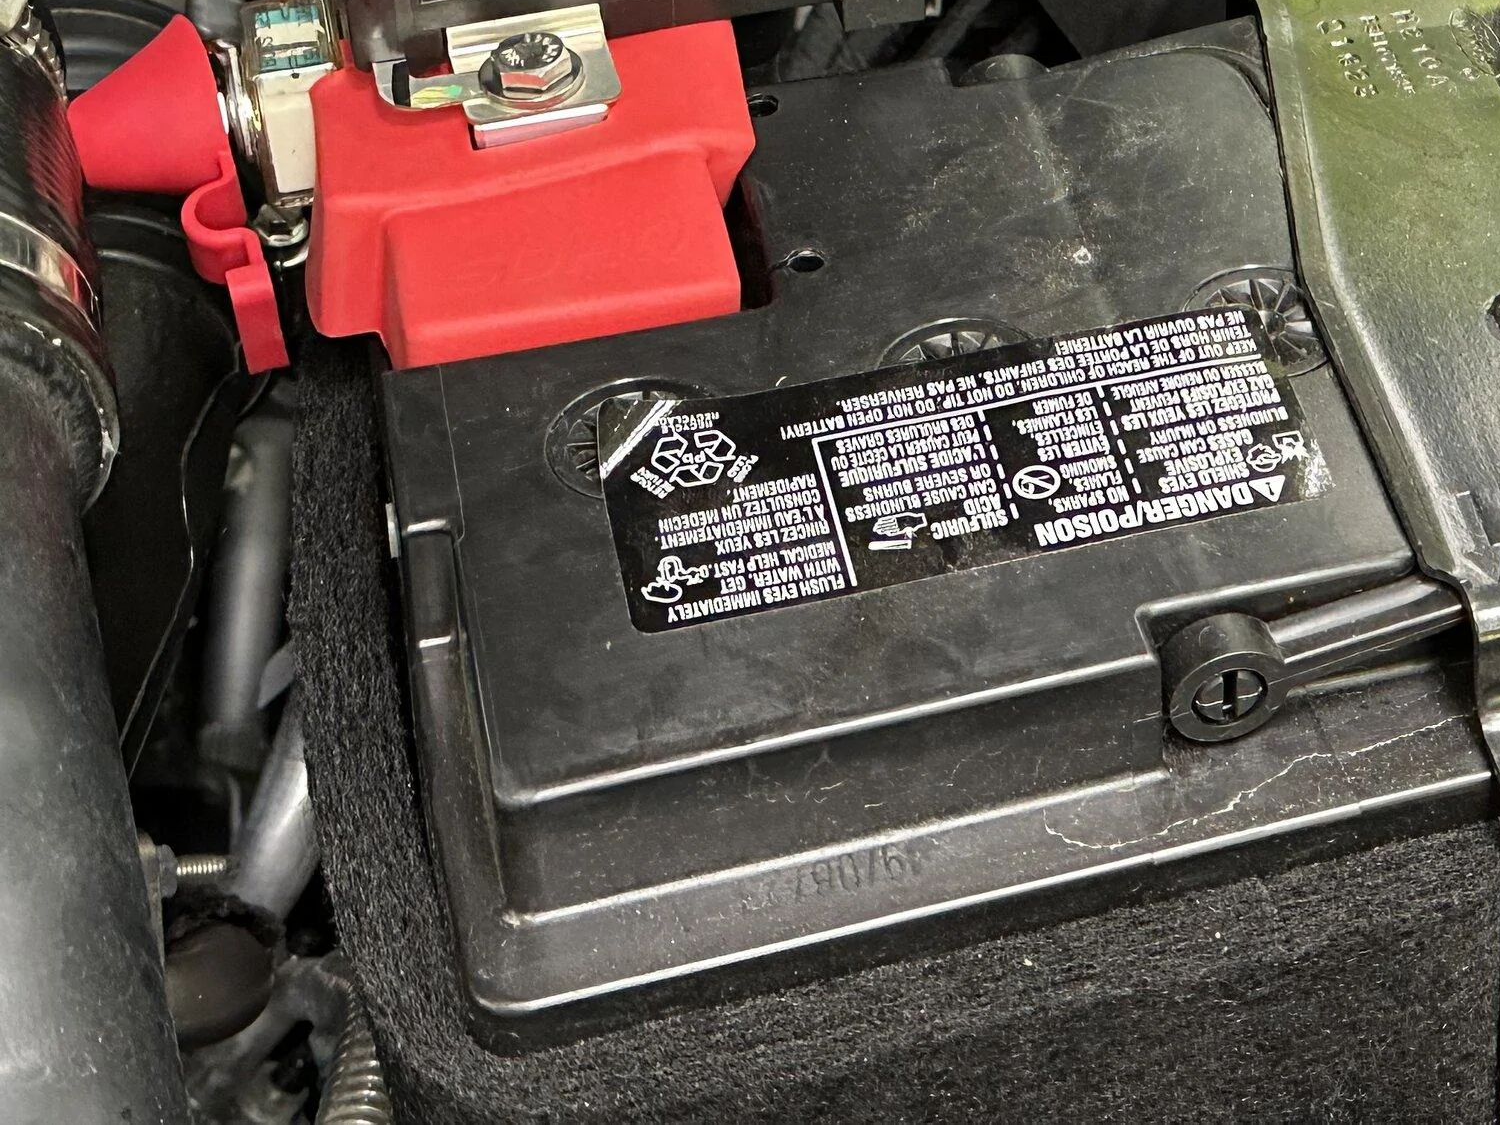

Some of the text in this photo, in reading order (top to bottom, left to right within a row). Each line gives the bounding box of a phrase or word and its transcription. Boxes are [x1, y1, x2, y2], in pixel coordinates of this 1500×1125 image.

[1196, 313, 1224, 329] PAS
[1224, 310, 1245, 325] NE
[1123, 327, 1143, 343] LA
[1144, 317, 1195, 339] OUVRIR
[1210, 324, 1251, 342] TENIR
[1149, 338, 1170, 353] DE
[1170, 330, 1209, 348] HORS
[1223, 338, 1256, 355] KEEP
[1129, 342, 1149, 357] LA
[1178, 347, 1195, 362] OF
[1197, 343, 1223, 359] OUT
[1046, 355, 1075, 371] DES
[1106, 357, 1150, 375] REACH
[1149, 351, 1177, 367] THE
[1087, 364, 1105, 379] OF
[1202, 367, 1220, 382] OU
[926, 379, 955, 396] PAS
[956, 375, 976, 390] NE
[994, 382, 1014, 398] DO
[966, 386, 993, 404] NOT
[1032, 391, 1092, 414] DE FUMER
[1130, 390, 1180, 412] PEUVENT
[886, 402, 913, 419] NOT
[914, 398, 935, 413] DO
[1074, 405, 1098, 422] LES
[1185, 400, 1212, 418] LES
[846, 408, 883, 426] OPEN
[949, 414, 974, 431] DES
[1120, 412, 1148, 430] LES
[1147, 405, 1185, 426] YEUX
[1149, 424, 1195, 444] INJURY
[1196, 419, 1216, 435] OR
[835, 432, 884, 453] GRAVES
[905, 435, 949, 455] CAUSER
[951, 428, 980, 446] PEUT
[1136, 428, 1253, 463] GASES CAN CAUSE
[887, 443, 904, 458] LA
[1037, 444, 1061, 461] LES
[830, 454, 848, 470] OU
[839, 443, 985, 486] L'ACIDE SULFURIQUE
[1059, 455, 1116, 478] SMOKING
[1164, 446, 1243, 475] EXPLOSIVE
[863, 463, 990, 501] OR SEVERE BURNS
[1158, 461, 1249, 493] SHIELD EYES
[743, 489, 820, 516] CONSULTEZ
[845, 478, 996, 521] CAN CAUSE BLINDNESS
[1106, 485, 1129, 503] NO
[721, 504, 742, 520] UN
[963, 493, 1000, 515] ACID
[774, 506, 813, 526] L'EAU
[1035, 483, 1251, 544] DANGER/POISON
[930, 509, 1007, 539] SULFURIC
[714, 519, 829, 554] RINCEZ LES YEUX
[746, 551, 779, 571] HELP
[779, 541, 835, 563] MEDICAL
[803, 557, 840, 577] WITH
[720, 575, 746, 594] GET
[668, 573, 844, 621] FLUSH EYES IMMEDIATELY
